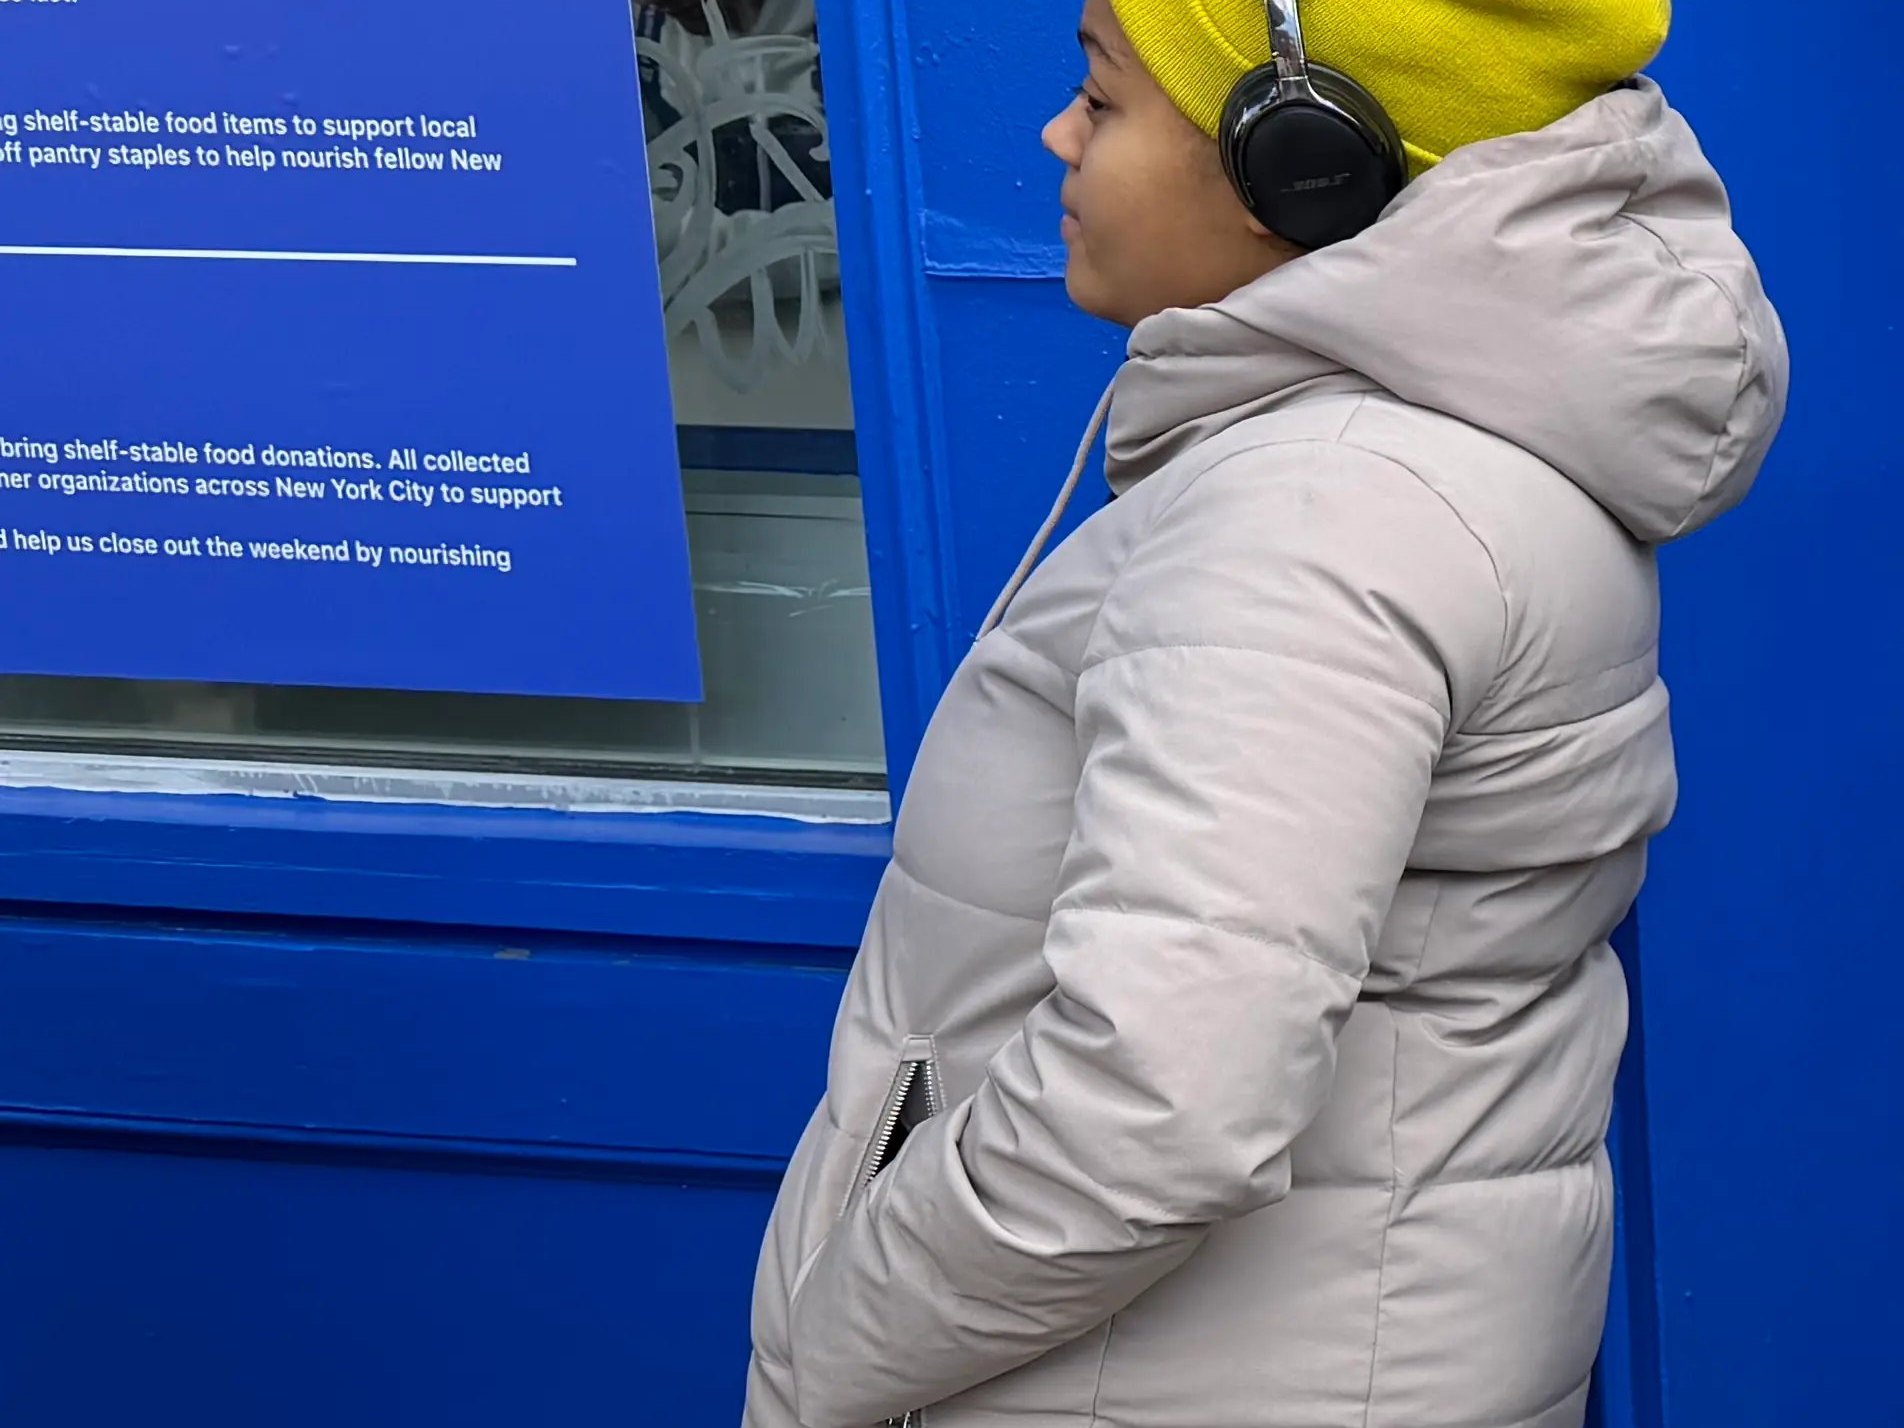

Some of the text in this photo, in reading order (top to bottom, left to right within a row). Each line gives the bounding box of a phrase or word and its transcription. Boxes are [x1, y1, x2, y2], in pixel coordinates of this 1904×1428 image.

[24, 109, 159, 133] shelf-stable
[165, 111, 217, 134] food
[223, 112, 287, 135] items
[292, 115, 316, 135] to
[323, 116, 415, 141] support
[420, 115, 476, 138] local
[29, 144, 101, 169] pantry
[108, 143, 191, 170] staples
[196, 146, 220, 166] to
[225, 145, 276, 171] help
[282, 146, 369, 168] nourish
[374, 147, 444, 170] fellow
[451, 149, 501, 171] New
[0, 437, 530, 473] bring shelf-stable food donations. All collected
[38, 472, 189, 495] organizations
[196, 479, 270, 497] across
[275, 477, 325, 498] New
[330, 479, 383, 500] York
[389, 480, 434, 507] City
[440, 483, 464, 503] to
[471, 487, 563, 509] support
[13, 529, 61, 555] help
[67, 536, 94, 552] us
[99, 532, 158, 554] close
[164, 537, 202, 556] out
[205, 536, 243, 557] the
[249, 539, 350, 561] weekend
[355, 540, 382, 567] by
[389, 543, 511, 572] nourishing
